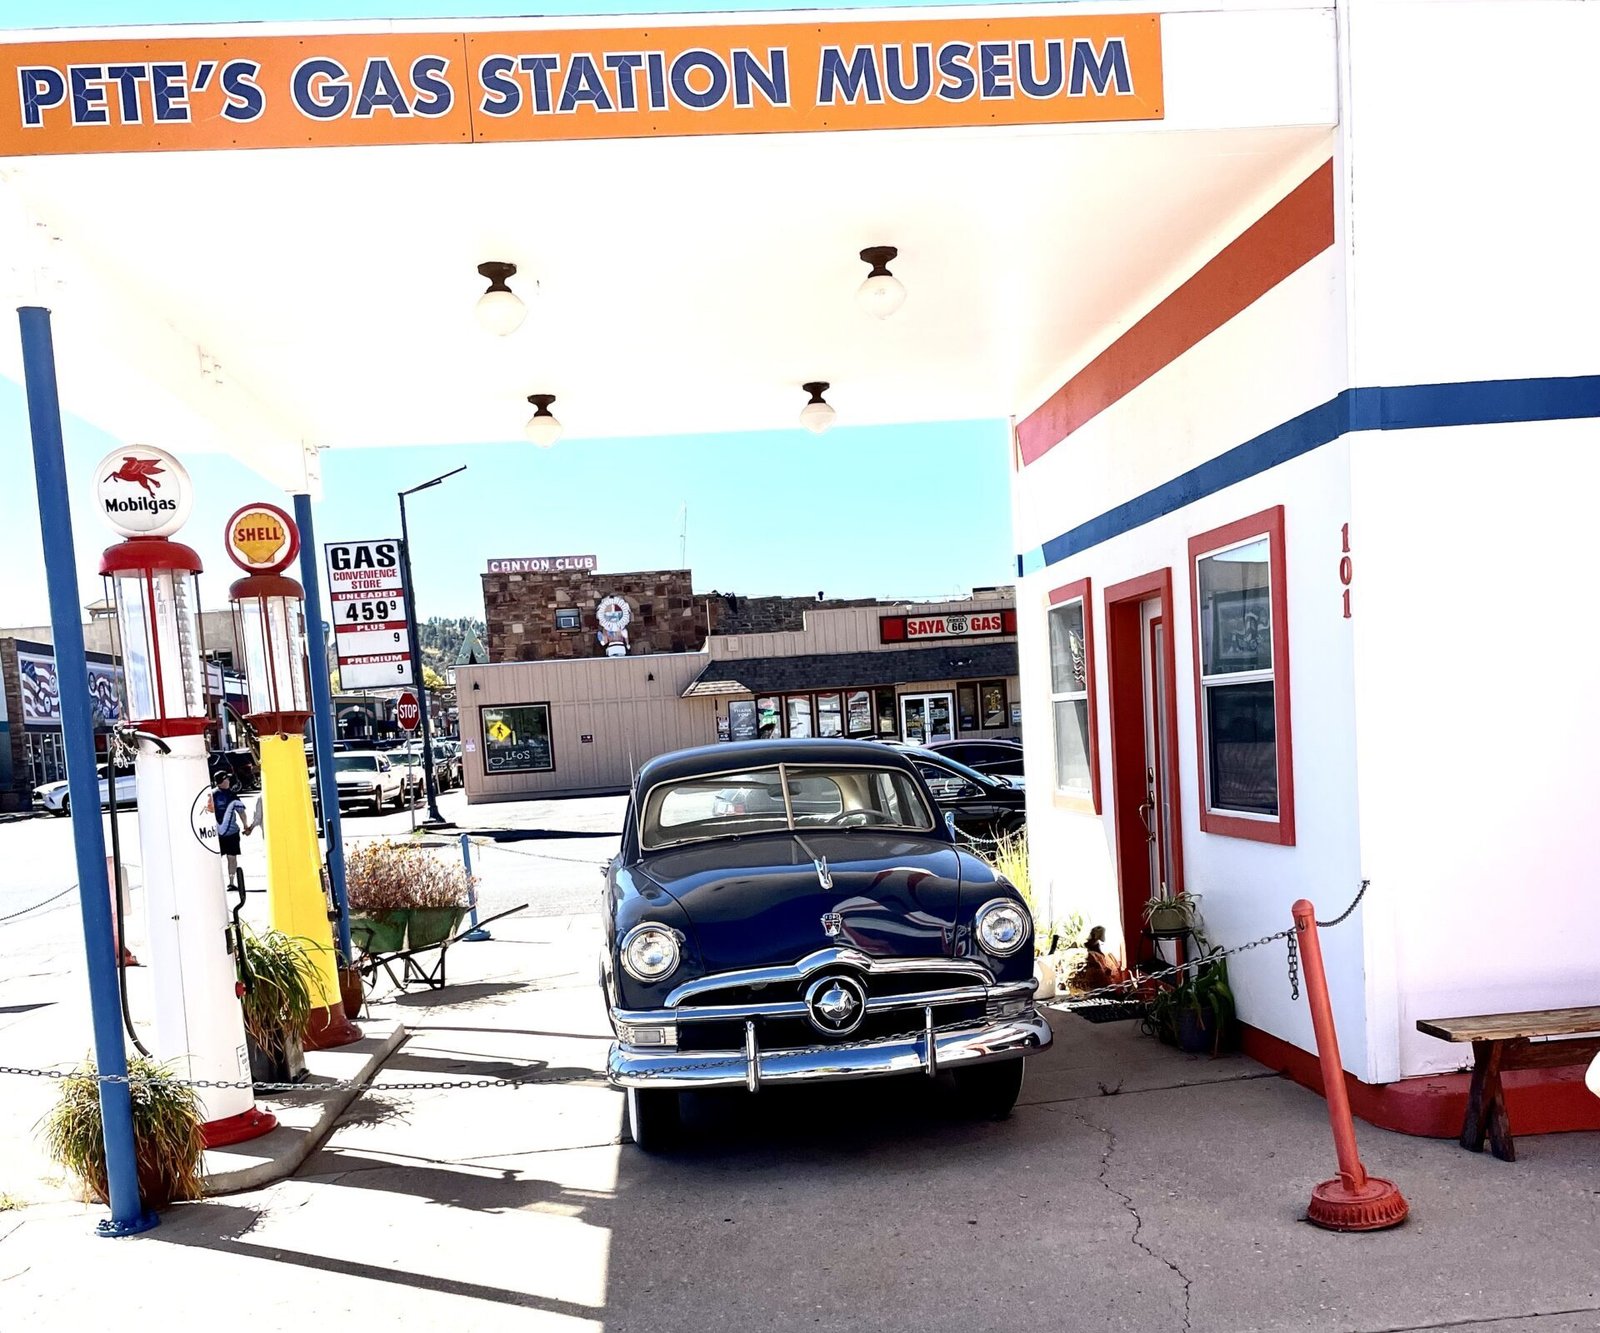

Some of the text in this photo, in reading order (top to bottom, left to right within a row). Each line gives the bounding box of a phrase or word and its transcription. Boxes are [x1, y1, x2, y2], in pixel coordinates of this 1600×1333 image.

[17, 36, 1136, 128] PETE'S GAS STATION MUSEUM
[105, 497, 176, 514] Mobilgas
[237, 526, 281, 543] SHELL
[331, 544, 396, 570] GAS
[490, 557, 594, 572] CANYON CLUB
[1339, 522, 1353, 619] 101
[333, 568, 397, 581] CONVENIENCE
[351, 579, 382, 590] STORE
[338, 591, 397, 600] UNLEADED
[356, 623, 386, 632] PLUS
[908, 619, 946, 636] SAYA
[951, 622, 964, 632] 66
[970, 616, 1001, 631] GAS
[393, 632, 400, 642] 9
[347, 654, 403, 665] PREMIUM
[396, 664, 404, 674] 9
[399, 704, 418, 719] STOP
[199, 826, 217, 839] Mob
